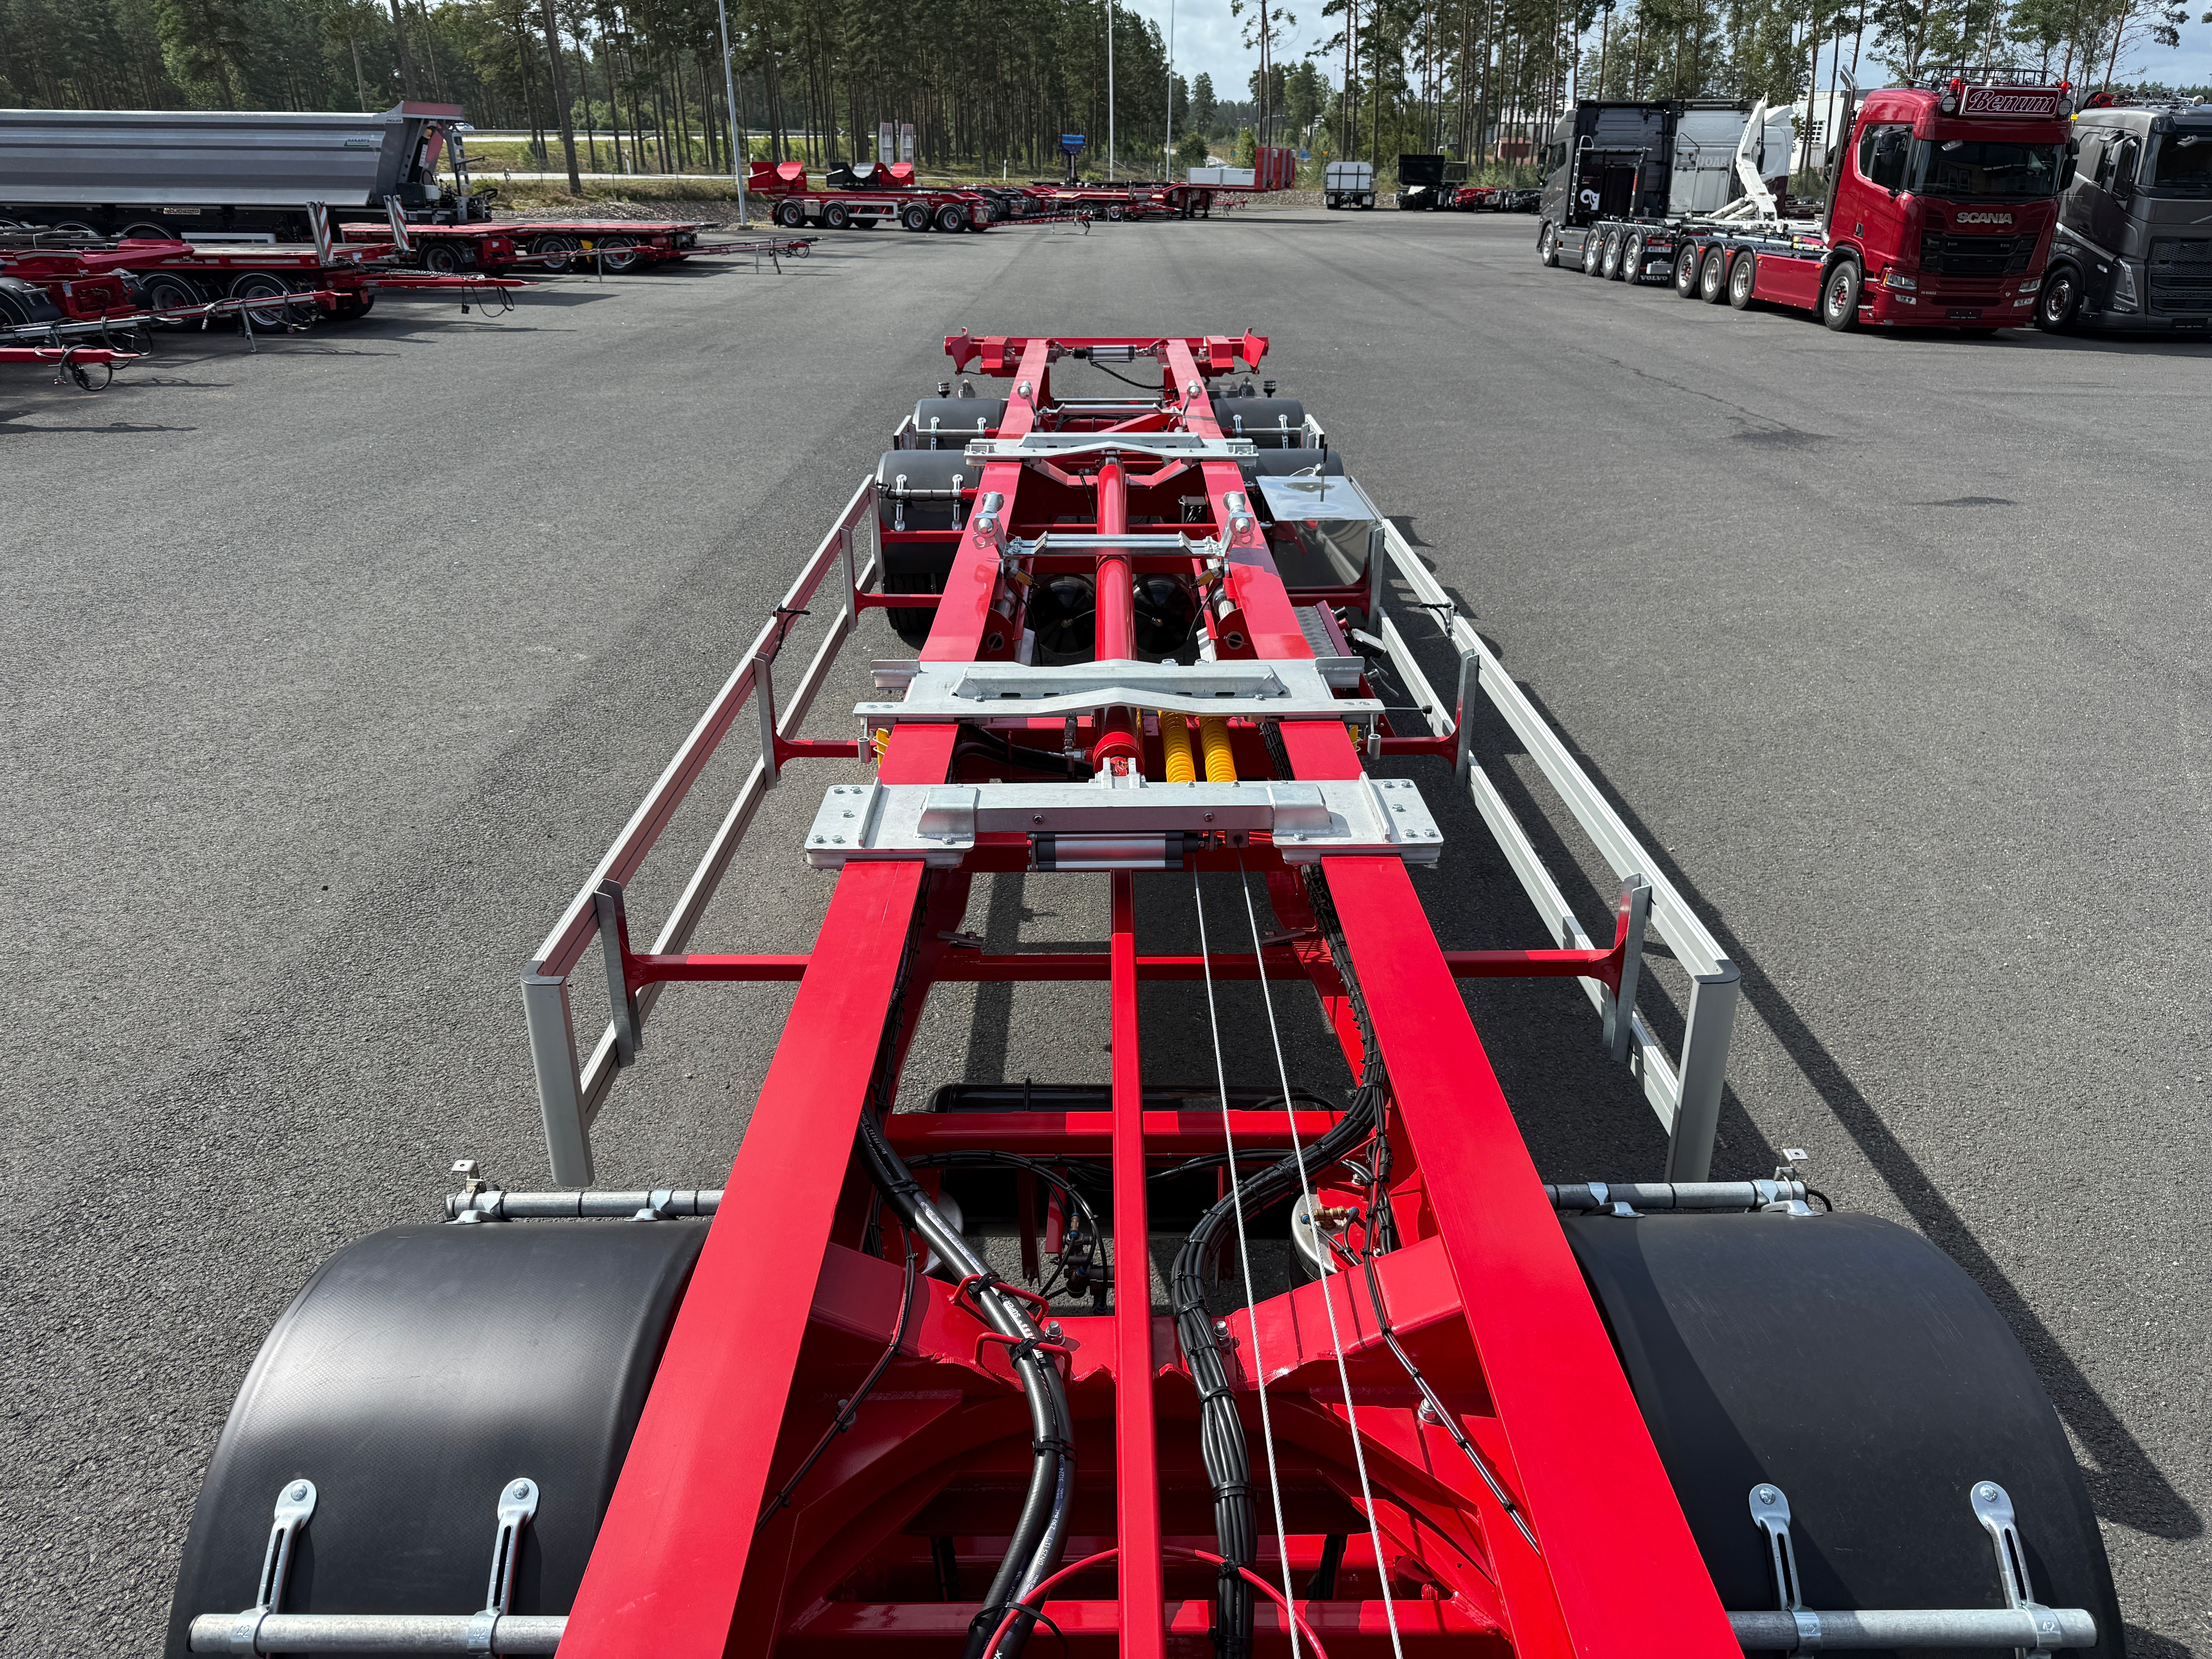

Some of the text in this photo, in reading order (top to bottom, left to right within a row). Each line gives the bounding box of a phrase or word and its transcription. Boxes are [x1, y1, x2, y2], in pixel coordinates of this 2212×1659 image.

[1968, 90, 2055, 112] Benum
[1956, 212, 2013, 224] SCANIA
[1005, 1300, 1021, 1318] SUPER
[1037, 1548, 1048, 1566] DN25
[237, 1625, 251, 1638] 42
[473, 1626, 486, 1639] 42
